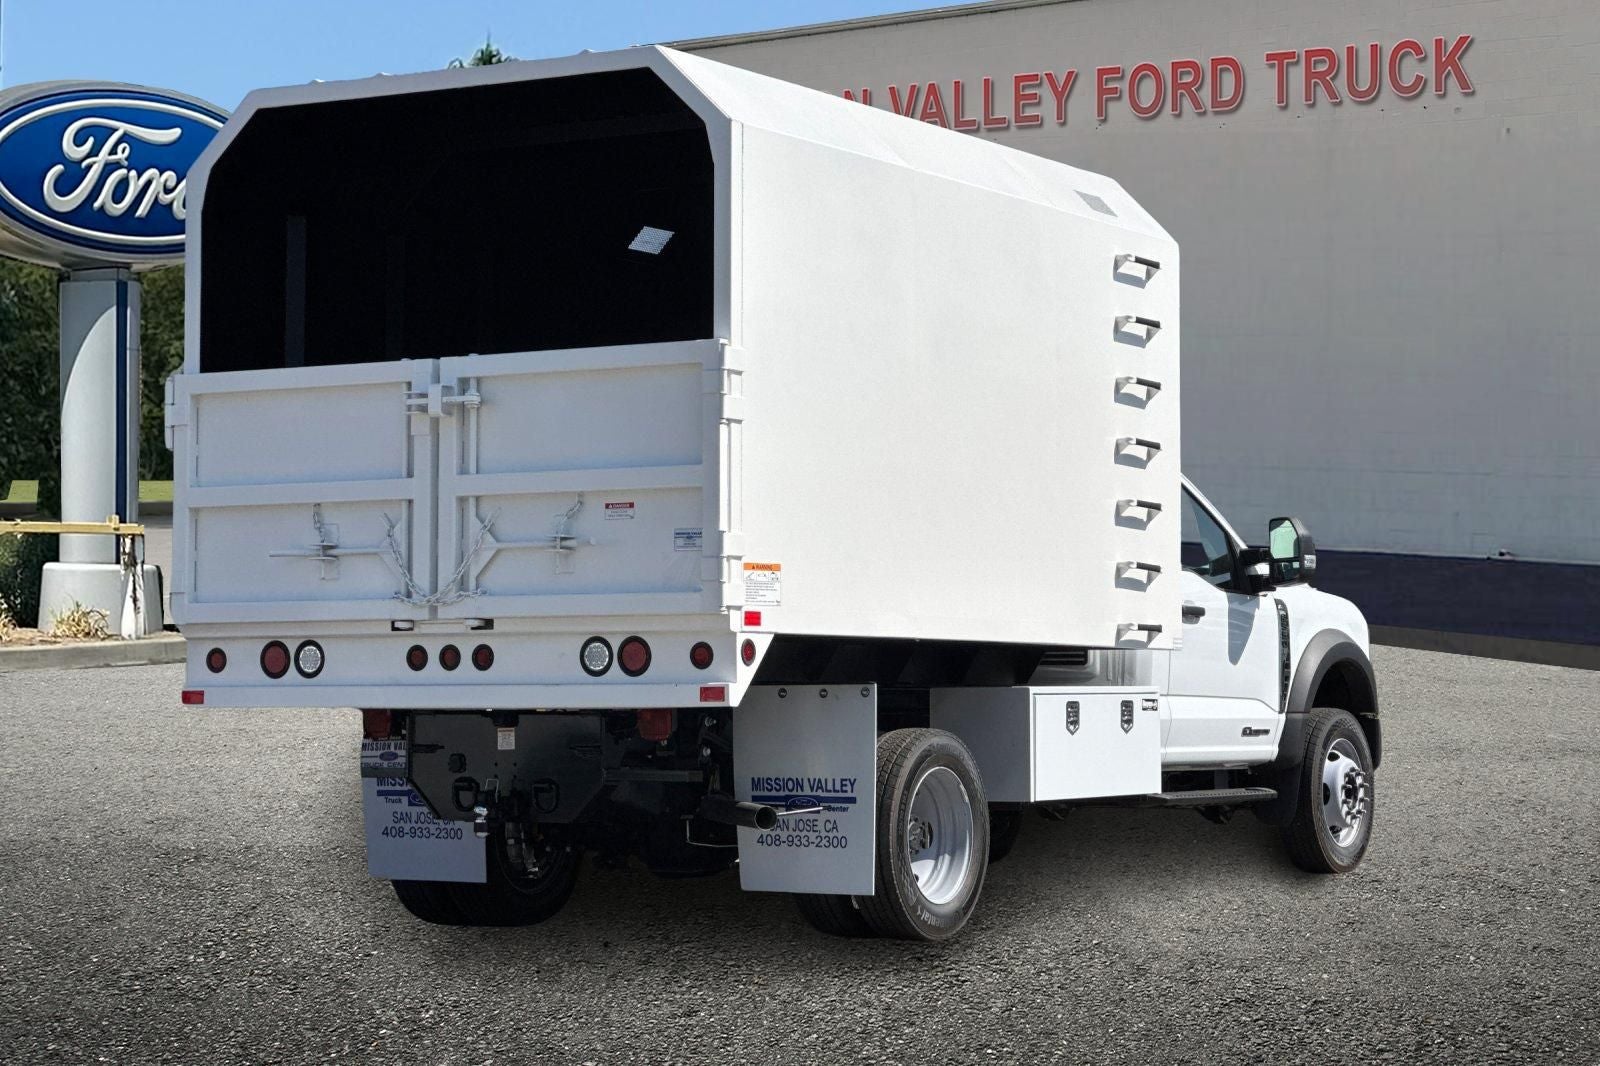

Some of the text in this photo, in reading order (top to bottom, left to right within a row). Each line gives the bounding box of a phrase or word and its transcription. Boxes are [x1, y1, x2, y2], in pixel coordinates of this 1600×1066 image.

[888, 34, 1474, 130] VALLEY FORD TRUCK
[362, 742, 391, 752] MISSION
[751, 777, 857, 794] MISSION VALLEY
[384, 796, 402, 804] Truck
[392, 811, 412, 824] SAN
[381, 826, 463, 839] 408-933-2300
[769, 819, 839, 834] AN JOSE, CA
[757, 833, 848, 849] 408-933-2300
